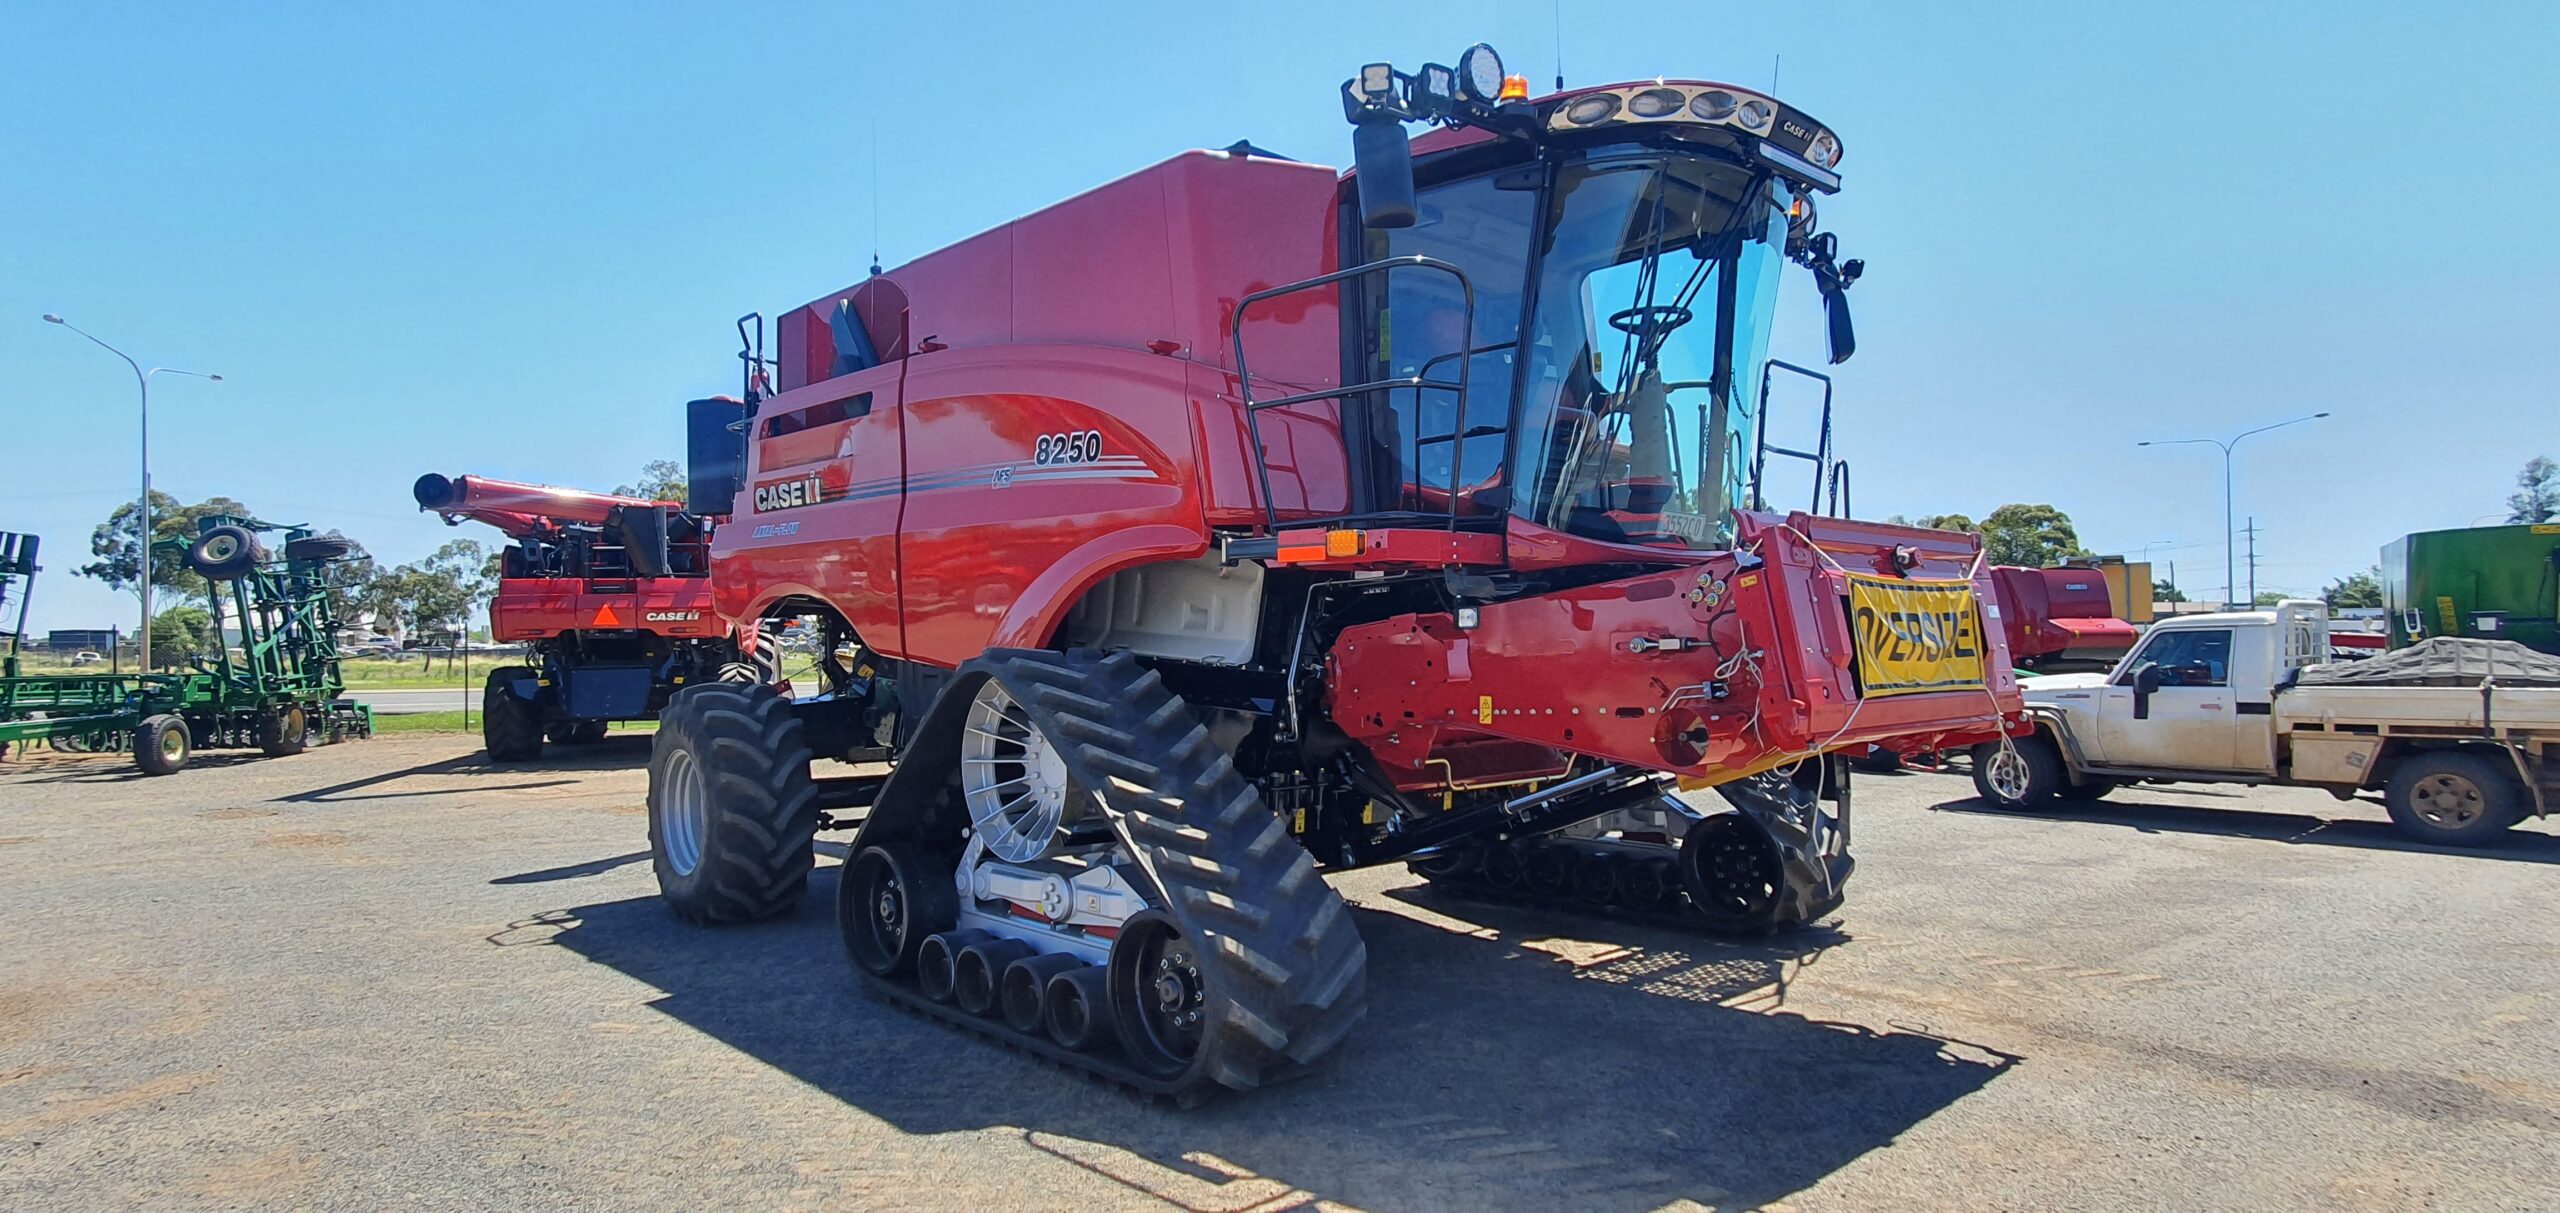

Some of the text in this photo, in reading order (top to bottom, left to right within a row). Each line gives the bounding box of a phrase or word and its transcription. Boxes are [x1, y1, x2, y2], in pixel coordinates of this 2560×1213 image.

[1783, 121, 1806, 138] CASE
[1035, 430, 1102, 466] 8250
[755, 481, 803, 511] CASE
[646, 612, 686, 621] CASE
[1858, 607, 1976, 663] OVERSIZE
